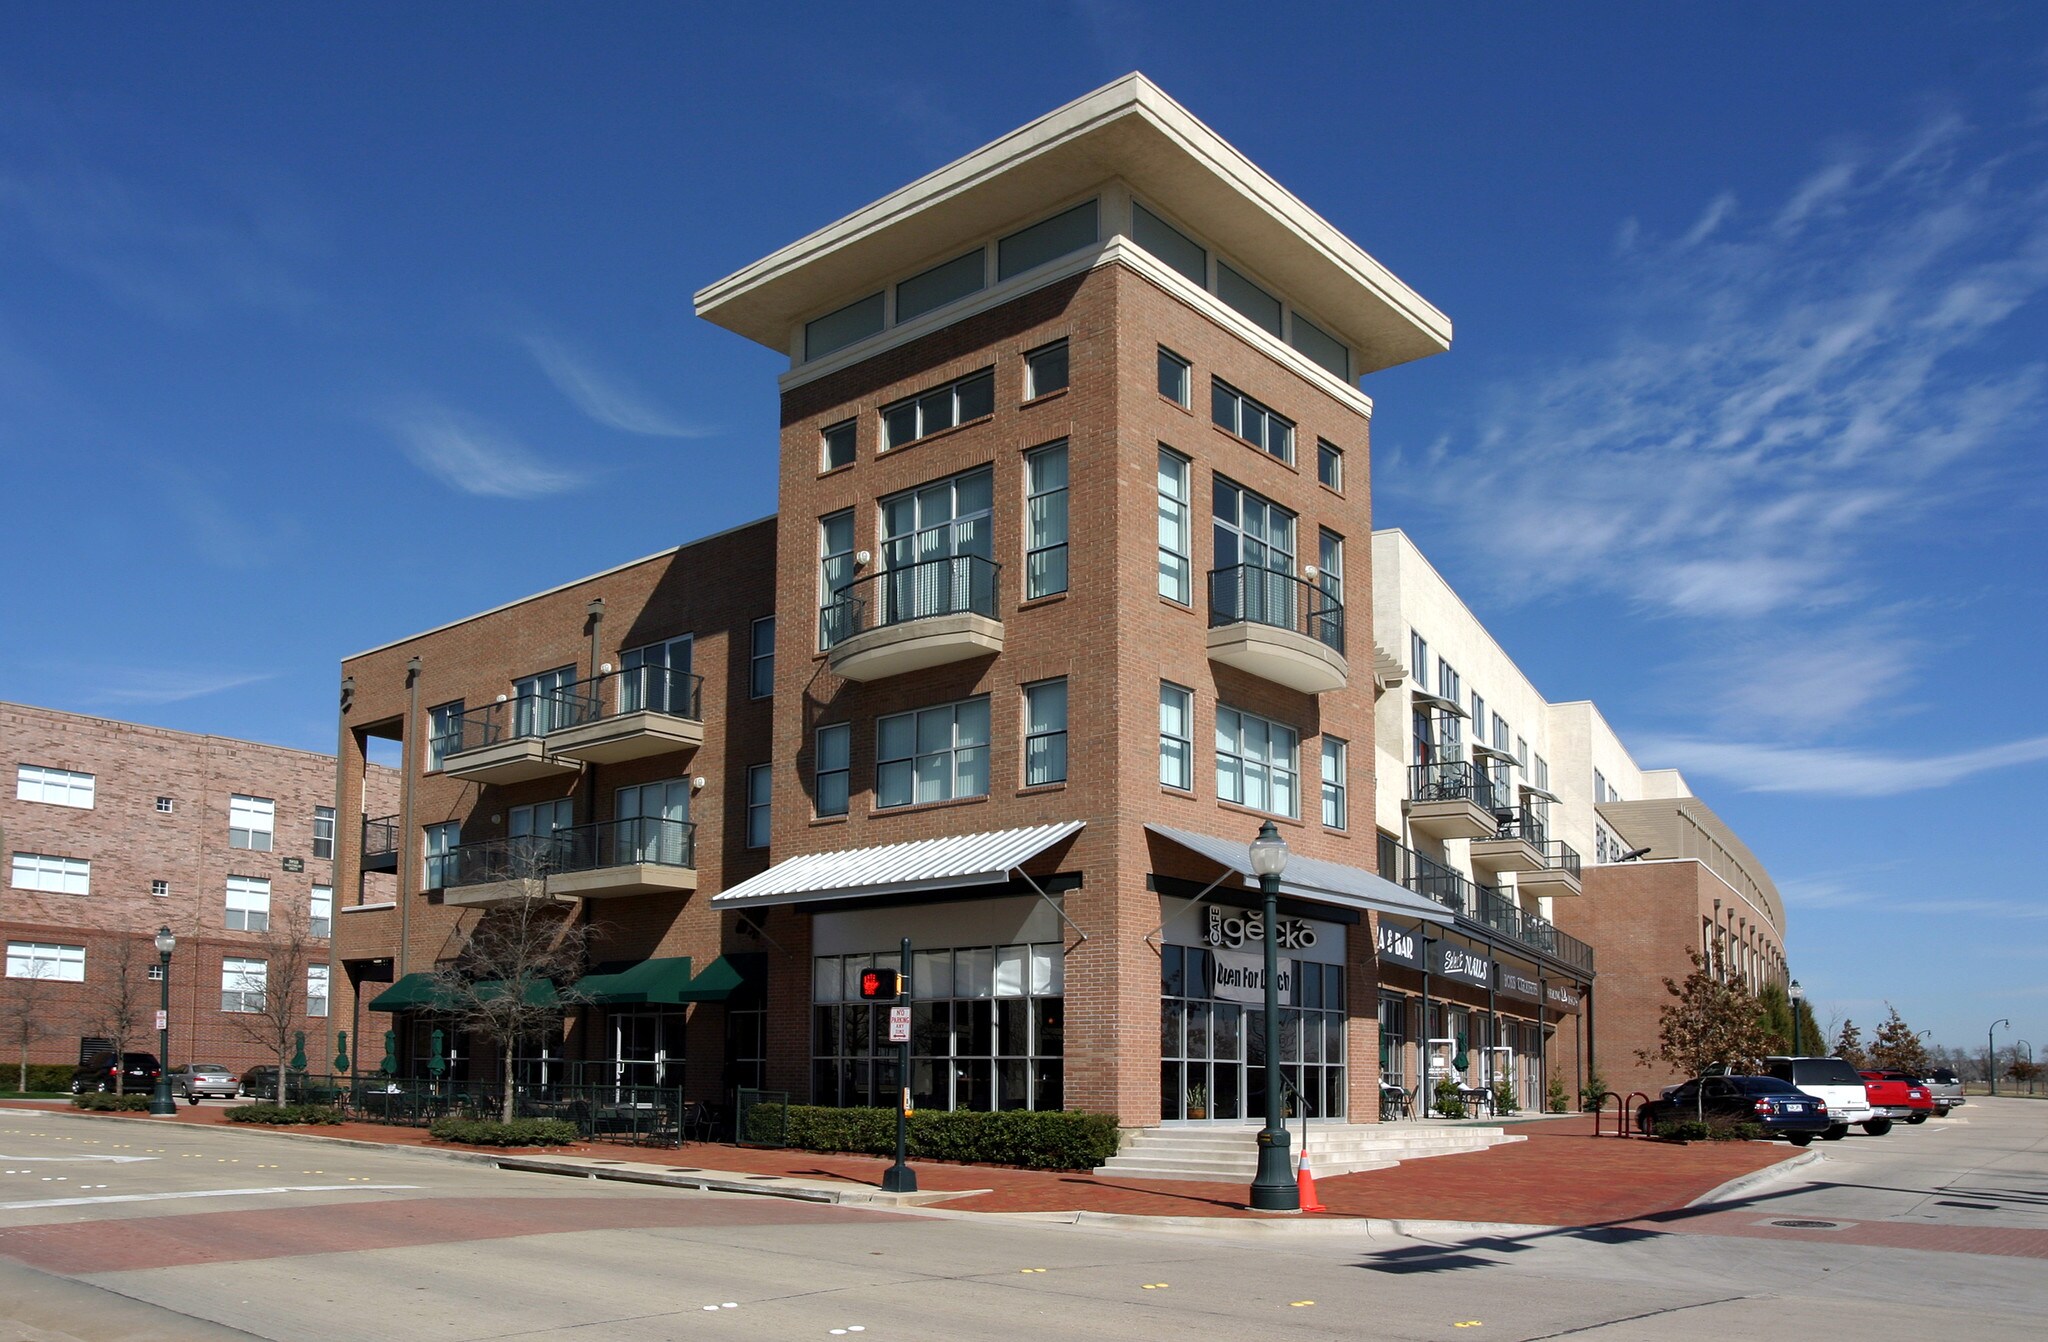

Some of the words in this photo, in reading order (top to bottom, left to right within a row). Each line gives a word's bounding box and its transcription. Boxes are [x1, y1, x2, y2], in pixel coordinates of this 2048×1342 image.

[1210, 905, 1221, 946] CAFE
[1387, 929, 1393, 953] &
[1395, 932, 1413, 959] BAR
[1217, 963, 1241, 986] Open
[1243, 967, 1259, 989] For
[1261, 969, 1290, 991] Lch
[1464, 955, 1488, 980] NAILS
